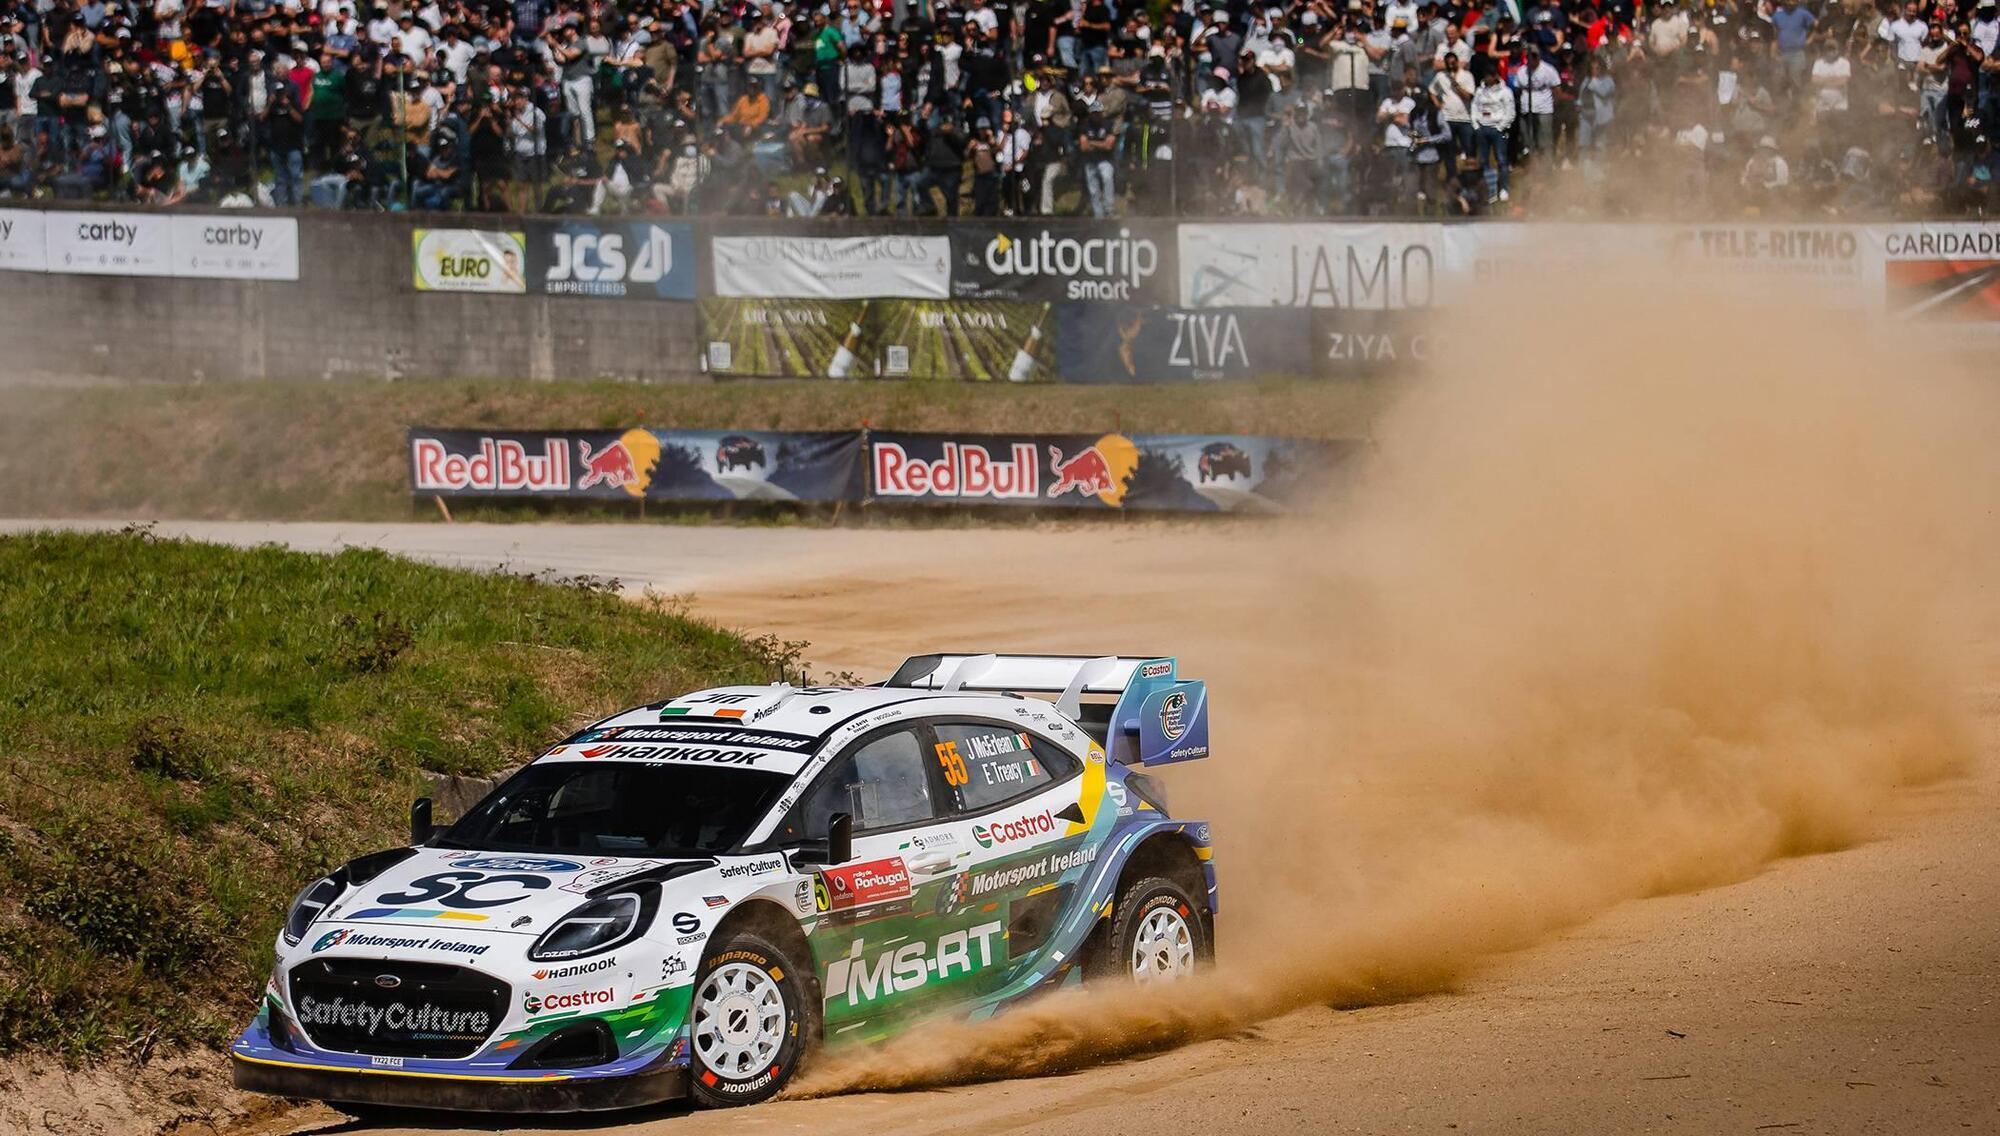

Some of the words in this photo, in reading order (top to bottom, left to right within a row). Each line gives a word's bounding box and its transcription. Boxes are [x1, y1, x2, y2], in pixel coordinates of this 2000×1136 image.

[78, 220, 138, 245] carby
[204, 223, 263, 249] carby
[1699, 230, 1857, 259] TELE-RITMO
[545, 232, 627, 281] JCS
[744, 238, 834, 262] QUINTA
[985, 228, 1158, 288] autocrip
[440, 256, 490, 278] EURO
[1271, 243, 1434, 307] JAMO
[1067, 279, 1130, 300] smart
[1166, 313, 1250, 367] ZIYA
[1328, 331, 1397, 360] ZIYA
[413, 437, 496, 489] Red
[497, 438, 571, 491] Bull
[873, 441, 959, 495] Red
[959, 442, 1039, 498] Bull
[1148, 663, 1171, 676] Castrol
[615, 728, 725, 742] Motorsport
[728, 731, 811, 748] Ireland
[965, 738, 975, 760] J
[972, 734, 1015, 759] McErlean
[934, 740, 969, 786] 55
[981, 763, 994, 785] E
[991, 761, 1024, 784] Treacy
[990, 809, 1055, 844] Castrol
[720, 856, 782, 879] SafetyCulture
[855, 870, 908, 890] Portugal
[971, 863, 1047, 896] Motorsport
[1050, 842, 1098, 873] Ireland
[375, 871, 552, 909] SC
[345, 933, 427, 950] Motorsport
[428, 938, 491, 956] Ireland
[544, 987, 614, 1010] Castrol
[300, 994, 490, 1037] SafetyCulture
